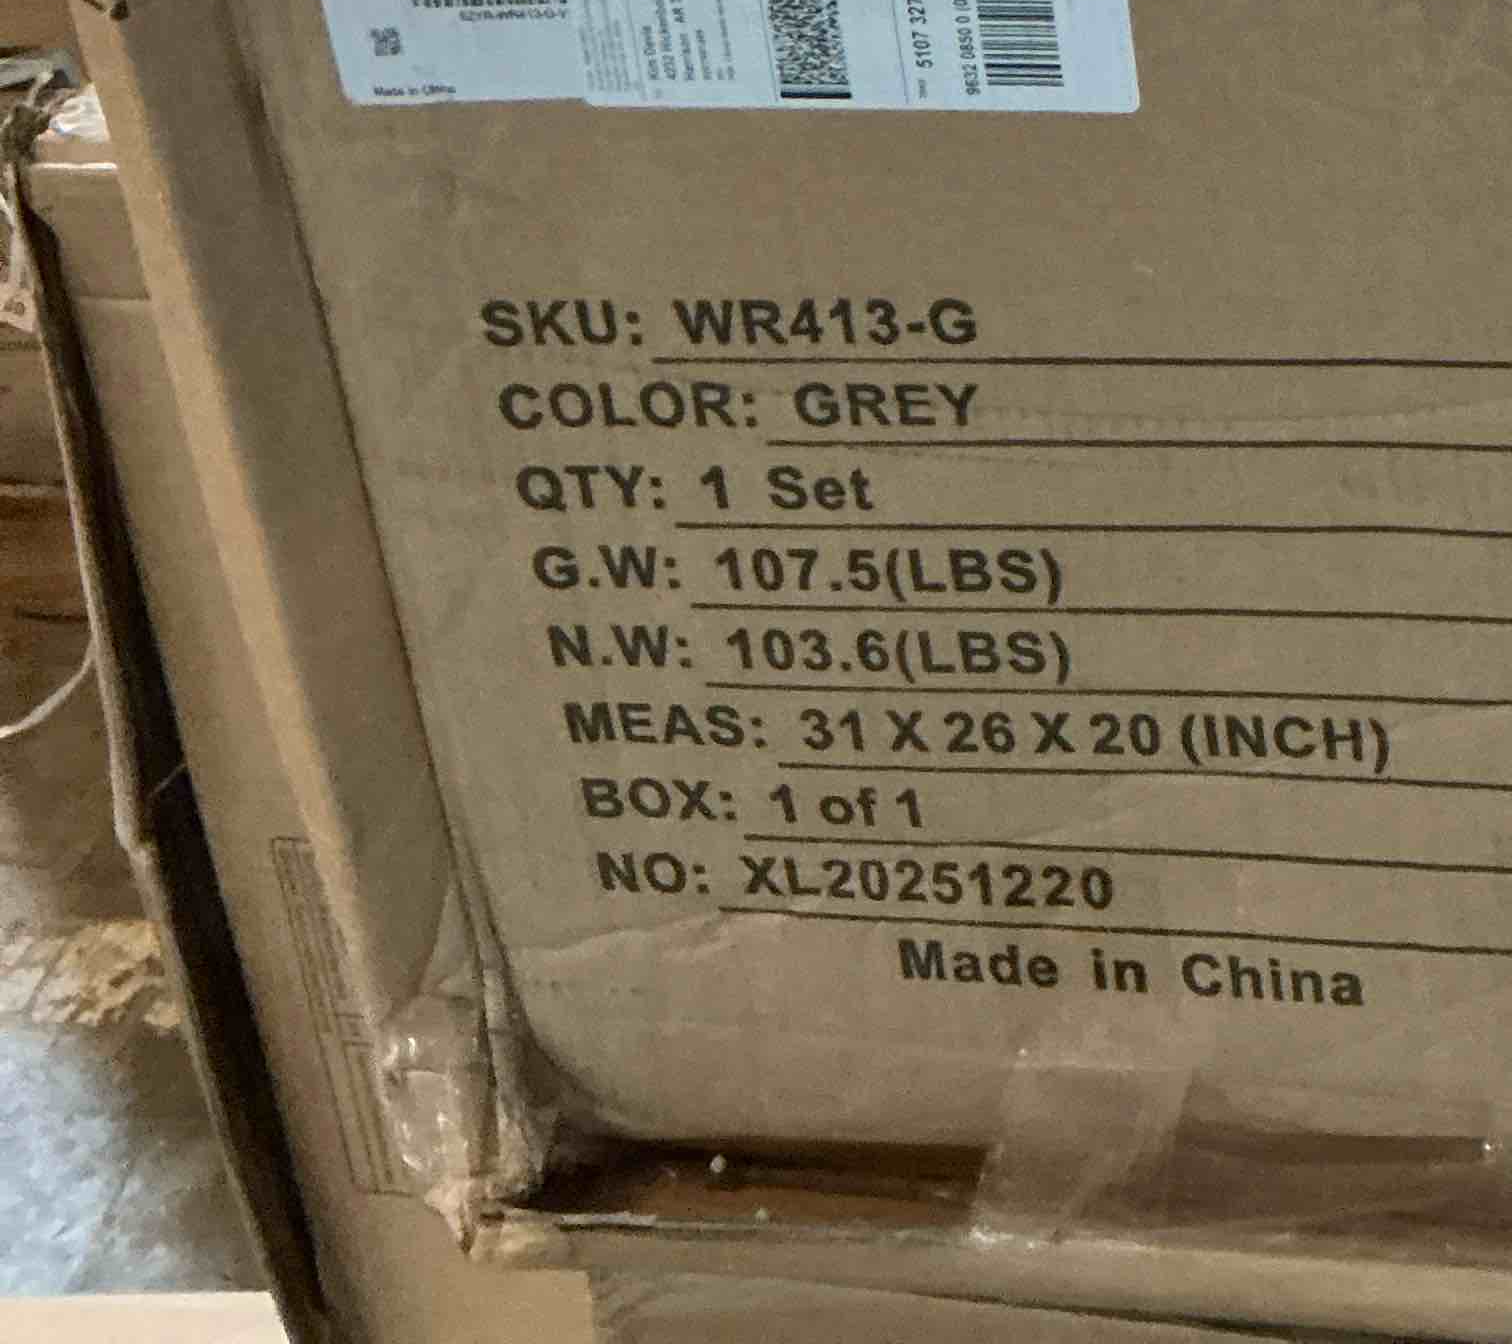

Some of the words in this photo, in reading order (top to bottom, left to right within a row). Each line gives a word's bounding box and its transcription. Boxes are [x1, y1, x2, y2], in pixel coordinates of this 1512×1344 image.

[911, 32, 934, 69] 5107
[480, 298, 644, 348] SKU:
[673, 297, 978, 346] WR413-G
[500, 381, 759, 430] COLOR:
[793, 380, 979, 427] GREY
[515, 465, 666, 511] QTY:
[700, 465, 730, 509] 1
[766, 465, 875, 511] Set
[532, 544, 681, 591] G.W:
[714, 547, 1062, 606] 107.5(LBS)
[548, 623, 694, 669] N.W:
[726, 627, 1071, 685] 103.6(LBS)
[562, 702, 768, 749] MEAS:
[800, 708, 866, 752] 31
[885, 709, 930, 754] X
[942, 710, 1016, 754] 26
[1032, 711, 1076, 755] X
[1092, 713, 1161, 757] 20
[1180, 713, 1391, 774] (INCH)
[580, 776, 738, 822] BOX:
[768, 782, 799, 825] 1
[818, 787, 878, 827] of
[895, 788, 924, 829] 1
[596, 850, 710, 895] NO:
[738, 854, 1114, 911] XL20251220
[898, 938, 1059, 989] Made
[1091, 947, 1150, 993] in
[1180, 952, 1364, 1007] China
